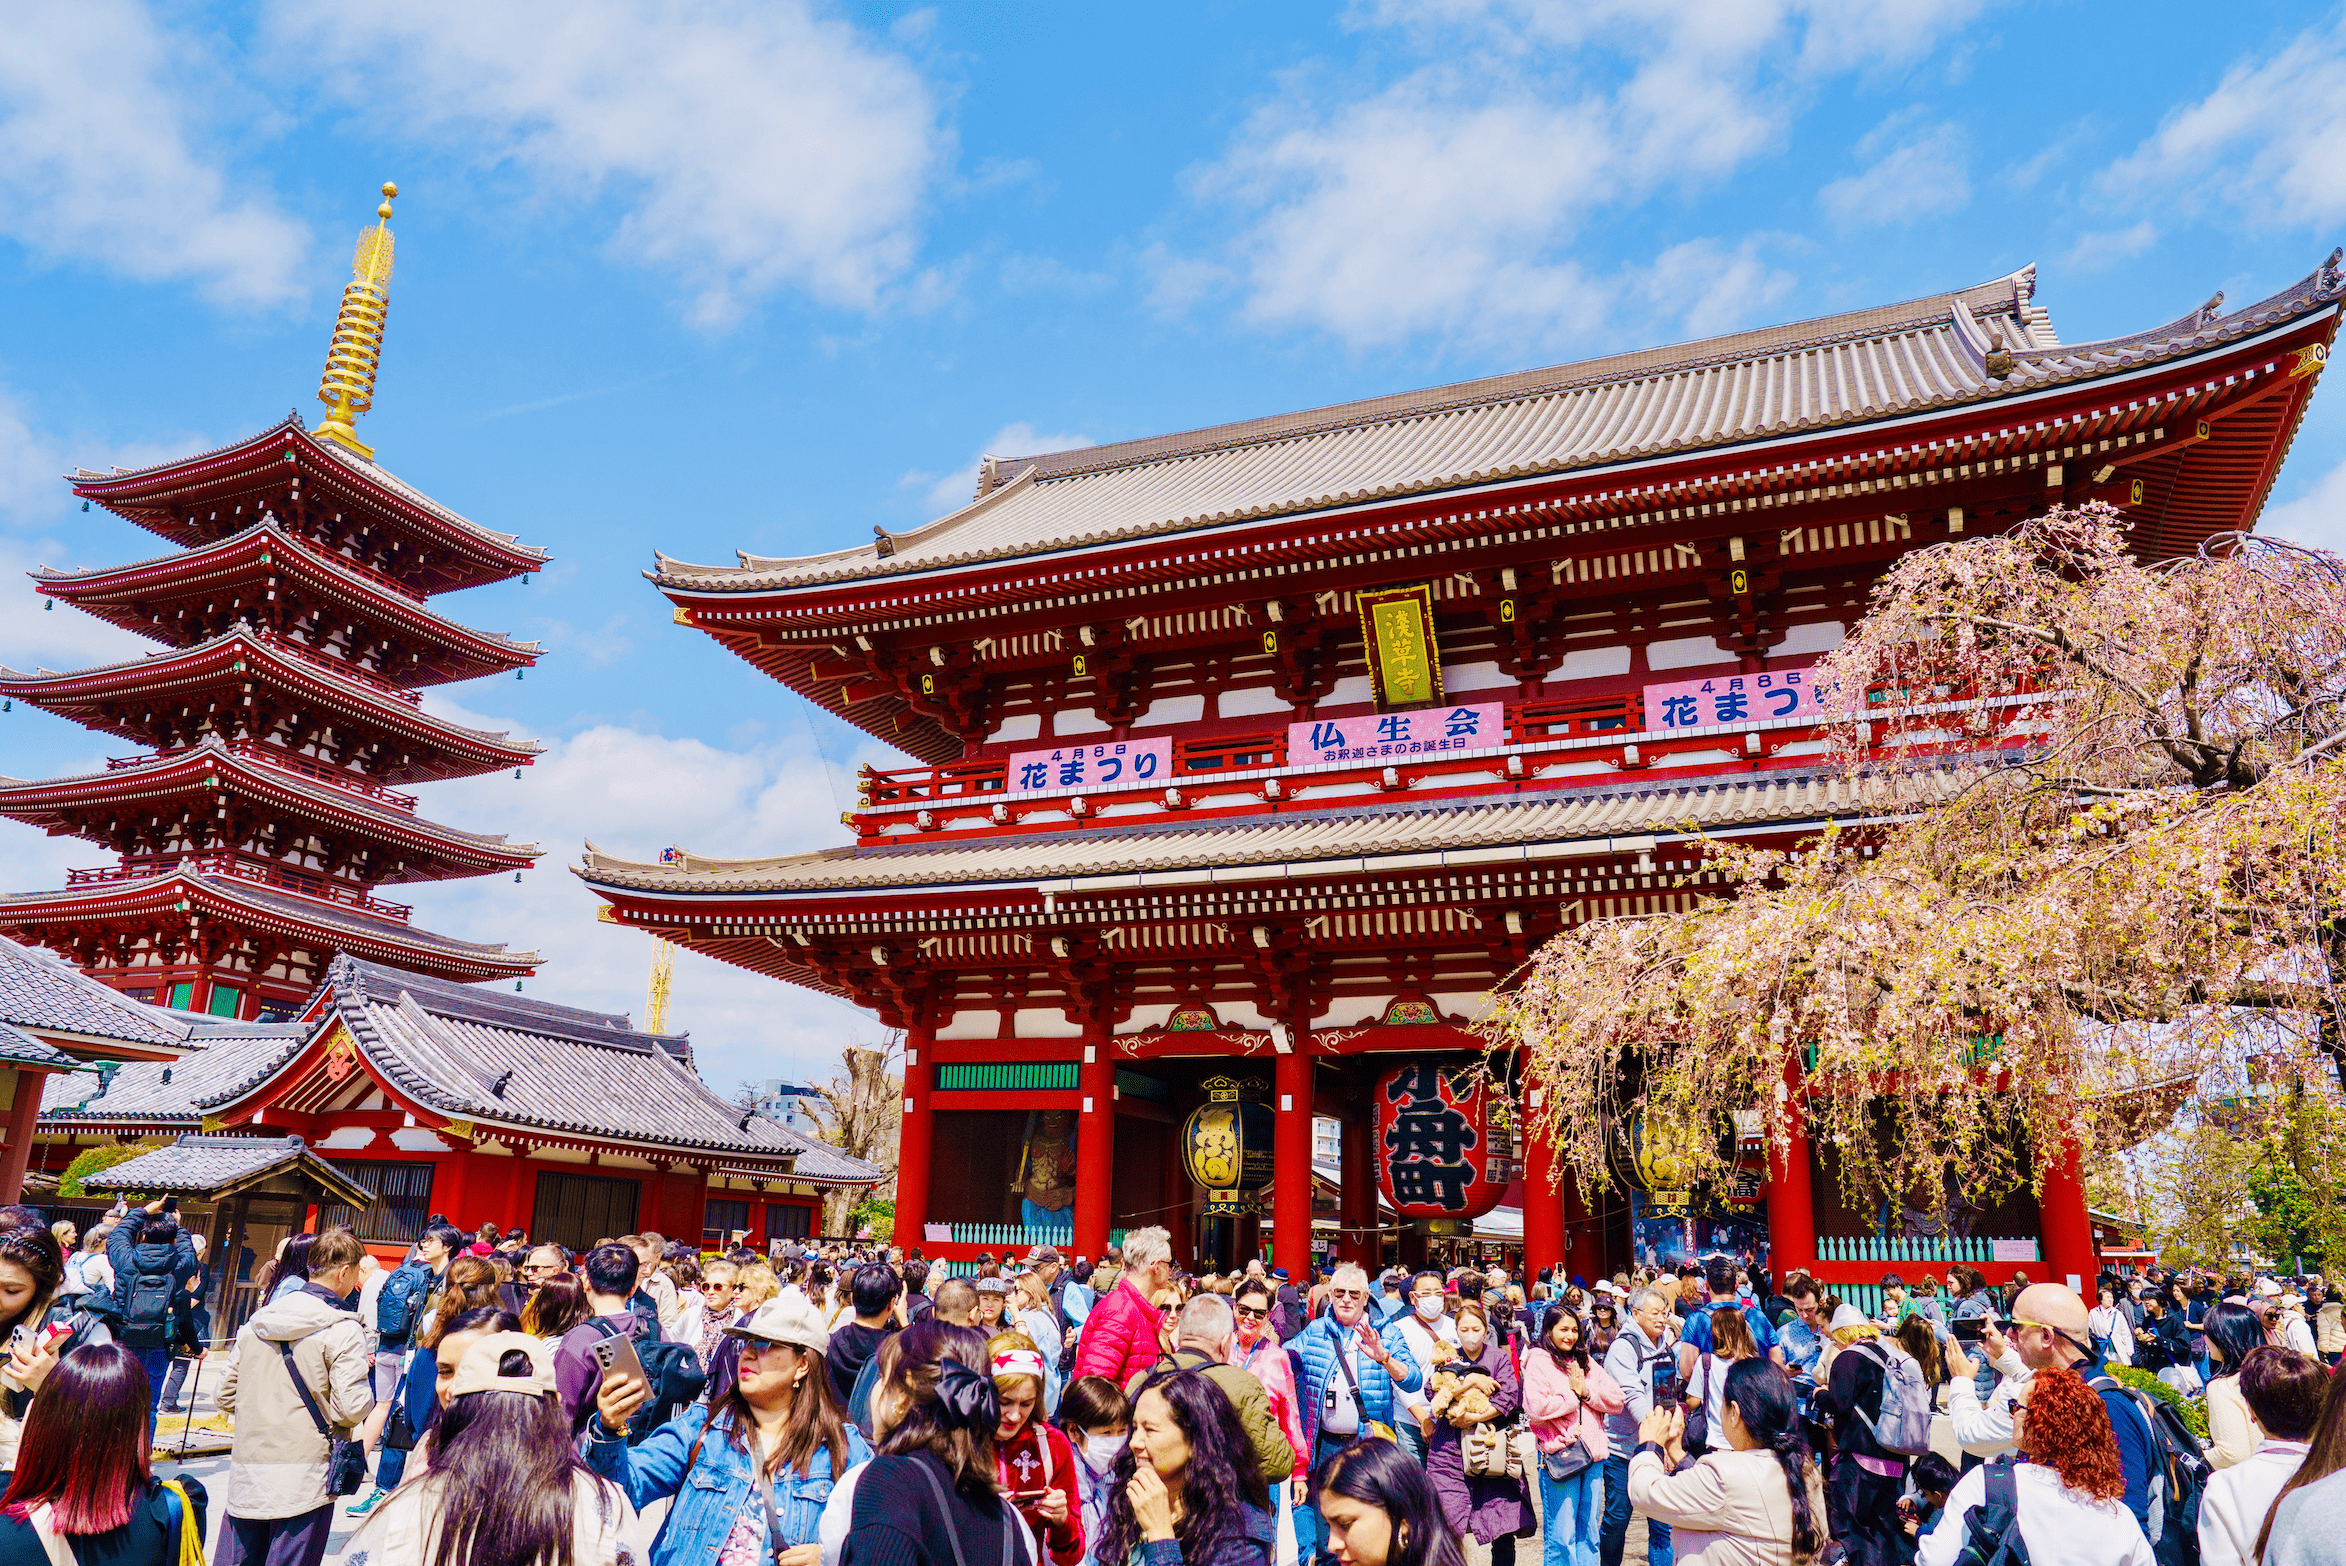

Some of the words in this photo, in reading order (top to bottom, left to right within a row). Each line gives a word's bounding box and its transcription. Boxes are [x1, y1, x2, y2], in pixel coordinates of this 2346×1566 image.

[1309, 707, 1481, 751] 仏生会
[1051, 744, 1126, 762] 4月8日
[1323, 737, 1466, 761] お釈迦さまのお誕生日
[1020, 752, 1157, 790] 花まつり
